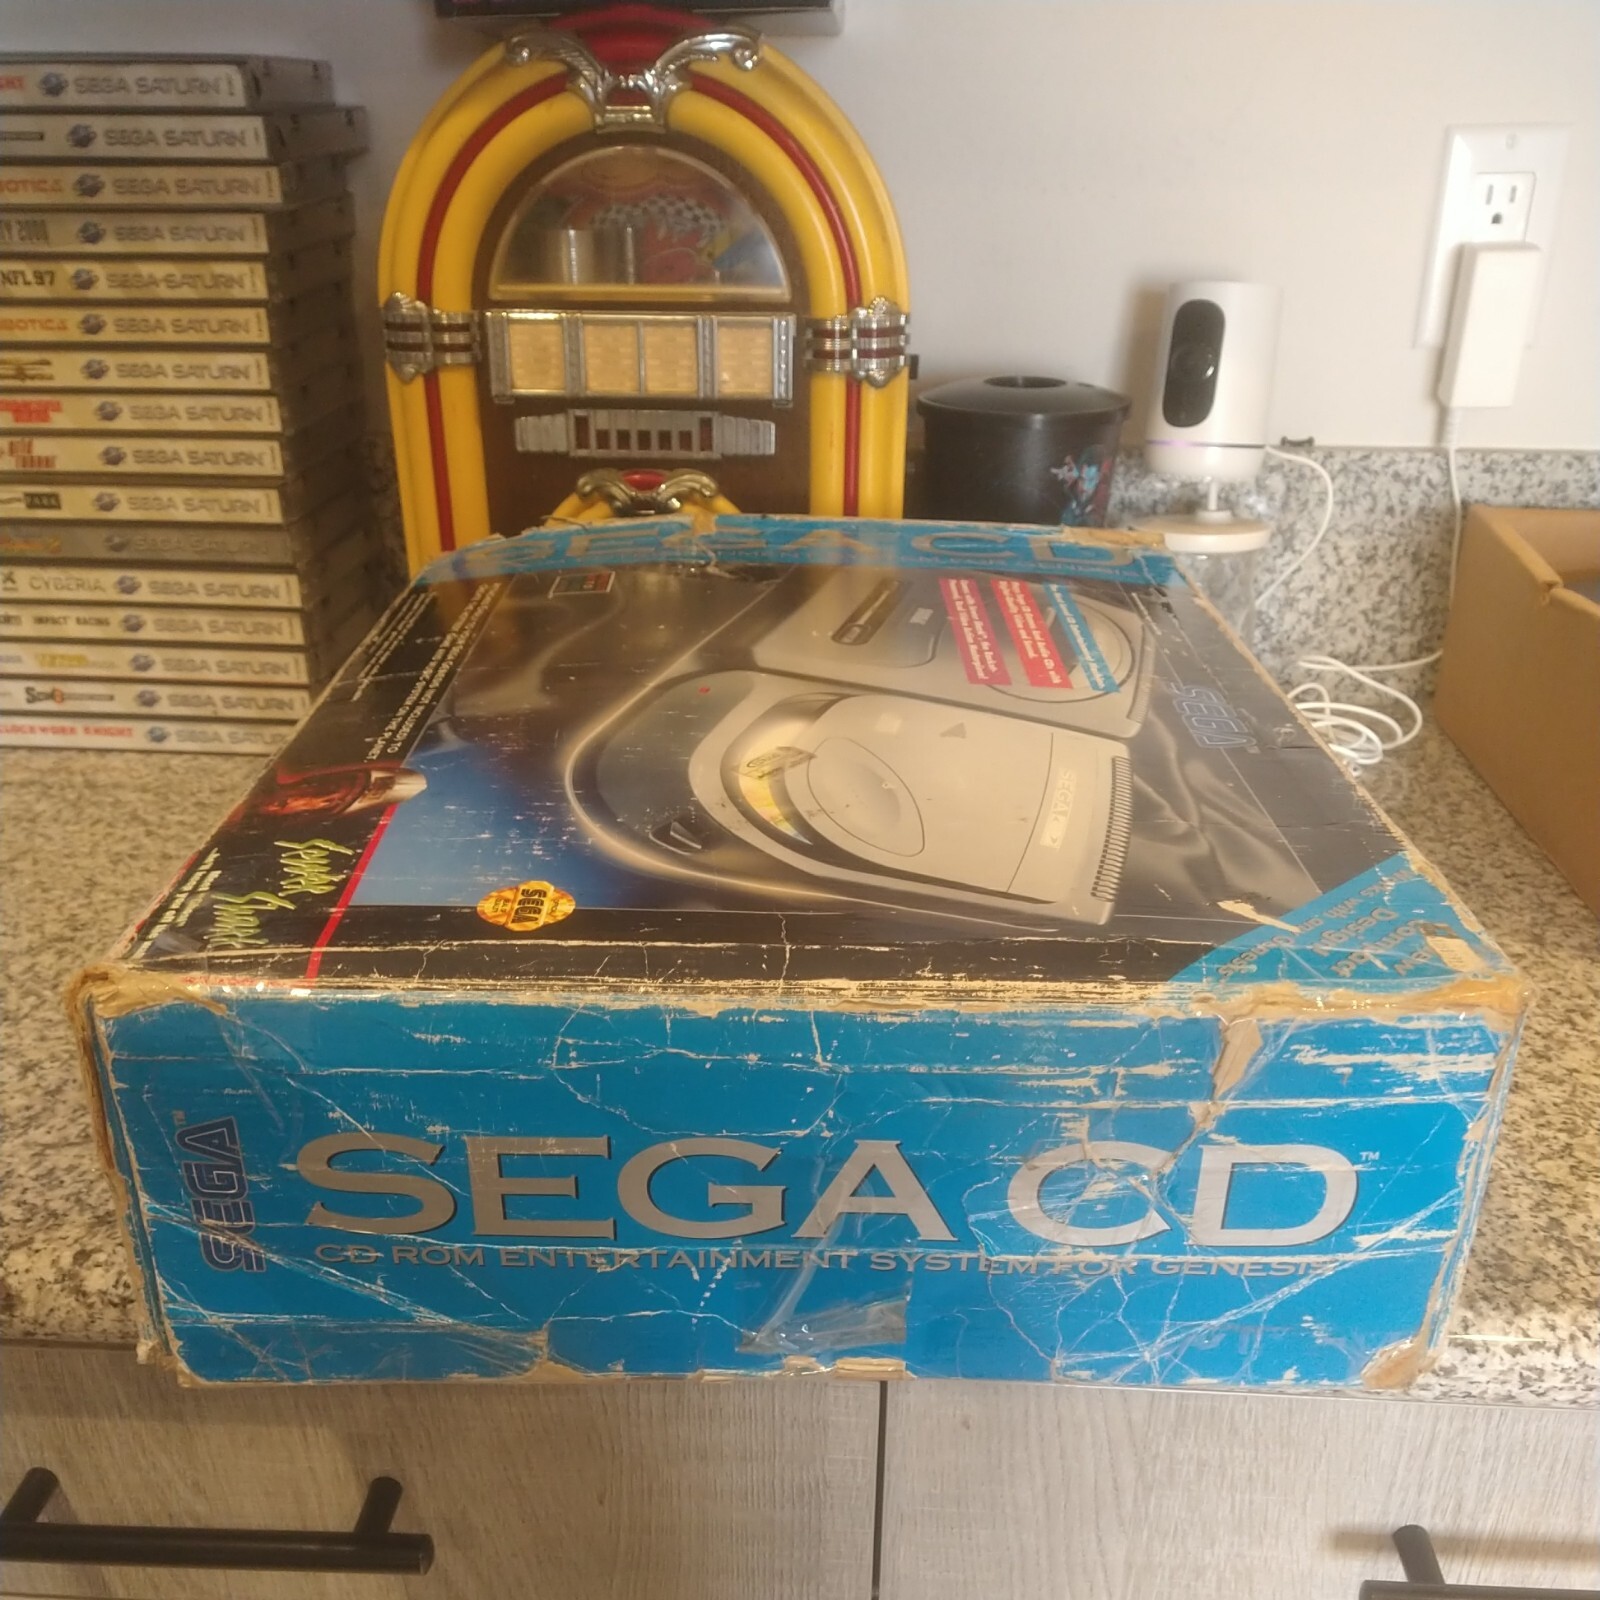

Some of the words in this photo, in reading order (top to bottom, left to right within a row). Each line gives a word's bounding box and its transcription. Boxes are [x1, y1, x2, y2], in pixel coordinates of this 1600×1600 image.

[74, 77, 129, 94] SEGA
[136, 77, 220, 95] SATURN
[103, 128, 158, 146] SEGA
[163, 129, 246, 147] SATURN
[113, 178, 169, 195] SEGA
[174, 178, 260, 196] SATURN
[113, 226, 166, 241] SEGA
[105, 272, 160, 289] SEGA
[165, 273, 245, 290] SATURN
[113, 318, 167, 334] SEGA
[171, 318, 249, 334] SATURN
[115, 362, 168, 379] SEGA
[172, 363, 249, 380] SATURN
[129, 405, 182, 421] SEGA
[186, 405, 263, 422] SATURN
[132, 449, 183, 465] SEGA
[187, 450, 264, 467] SATURN
[126, 496, 179, 511] SEGA
[183, 497, 260, 514] SATURN
[29, 576, 106, 592] CYBERIA
[148, 580, 199, 595] SEGA
[203, 581, 280, 598] SATURN
[153, 618, 202, 633] SEGA
[207, 619, 283, 635] SATURN
[162, 658, 212, 673] SEGA
[216, 659, 290, 675] SATURN
[167, 694, 217, 709] SEGA
[222, 695, 295, 711] SATURN
[1165, 683, 1257, 748] SEGA
[510, 888, 548, 924] SEGA
[175, 1116, 267, 1273] SEGA
[296, 1131, 961, 1243] SEGA
[1005, 1139, 1360, 1249] CD
[392, 1246, 486, 1268] ROM
[500, 1247, 858, 1271] ENTERTAINMENT
[870, 1250, 1038, 1275] SYSTEM
[1150, 1260, 1335, 1278] GENESIS
